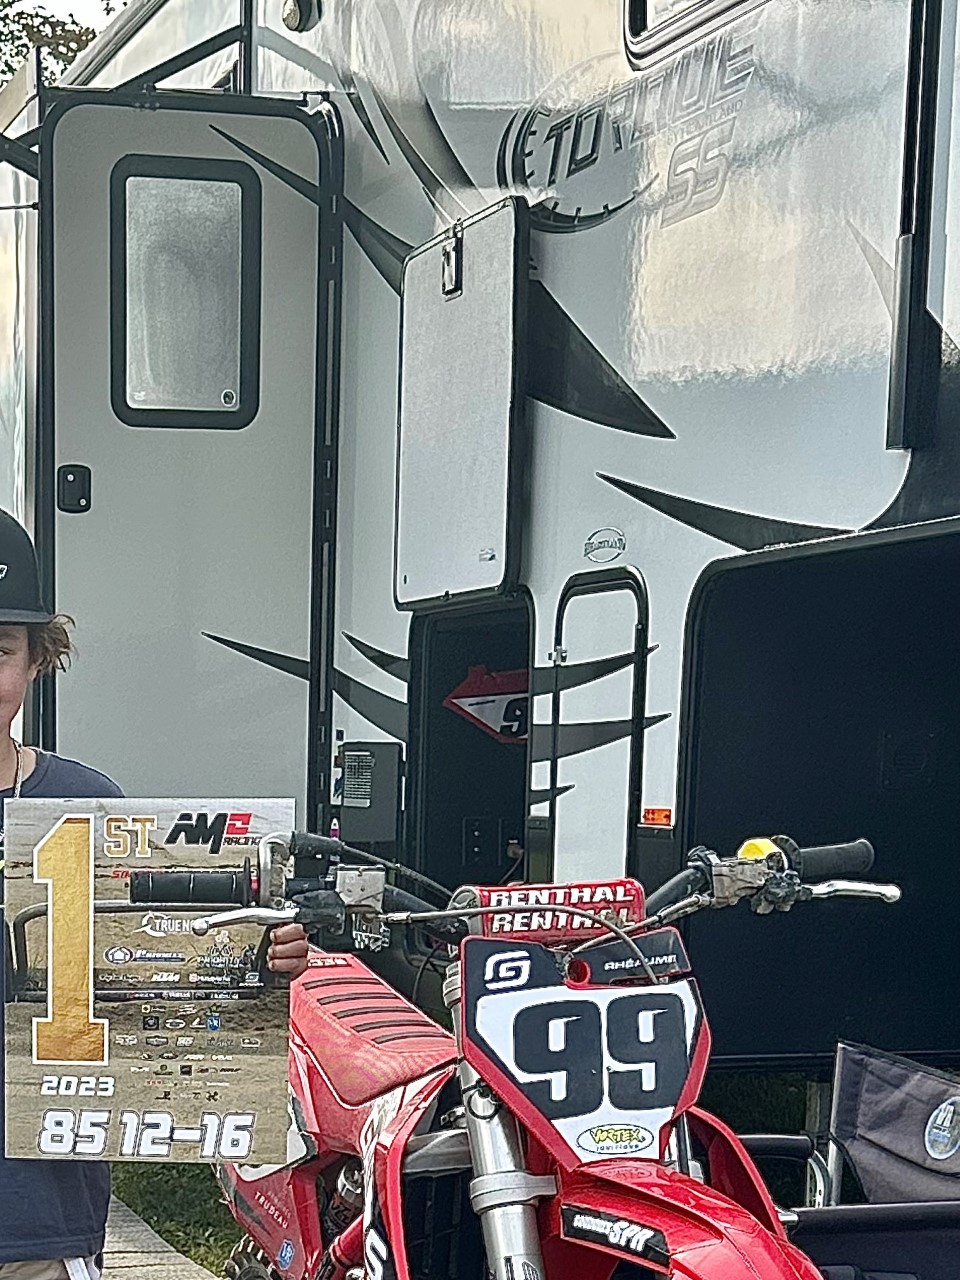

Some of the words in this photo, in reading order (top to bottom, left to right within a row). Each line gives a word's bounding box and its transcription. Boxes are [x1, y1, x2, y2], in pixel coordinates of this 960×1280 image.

[490, 884, 634, 907] RENTHAL
[513, 993, 688, 1121] 99
[40, 1075, 116, 1097] 2023
[37, 1109, 111, 1156] 85
[117, 1110, 256, 1160] 12-16
[254, 1191, 289, 1230] TRUDEAU
